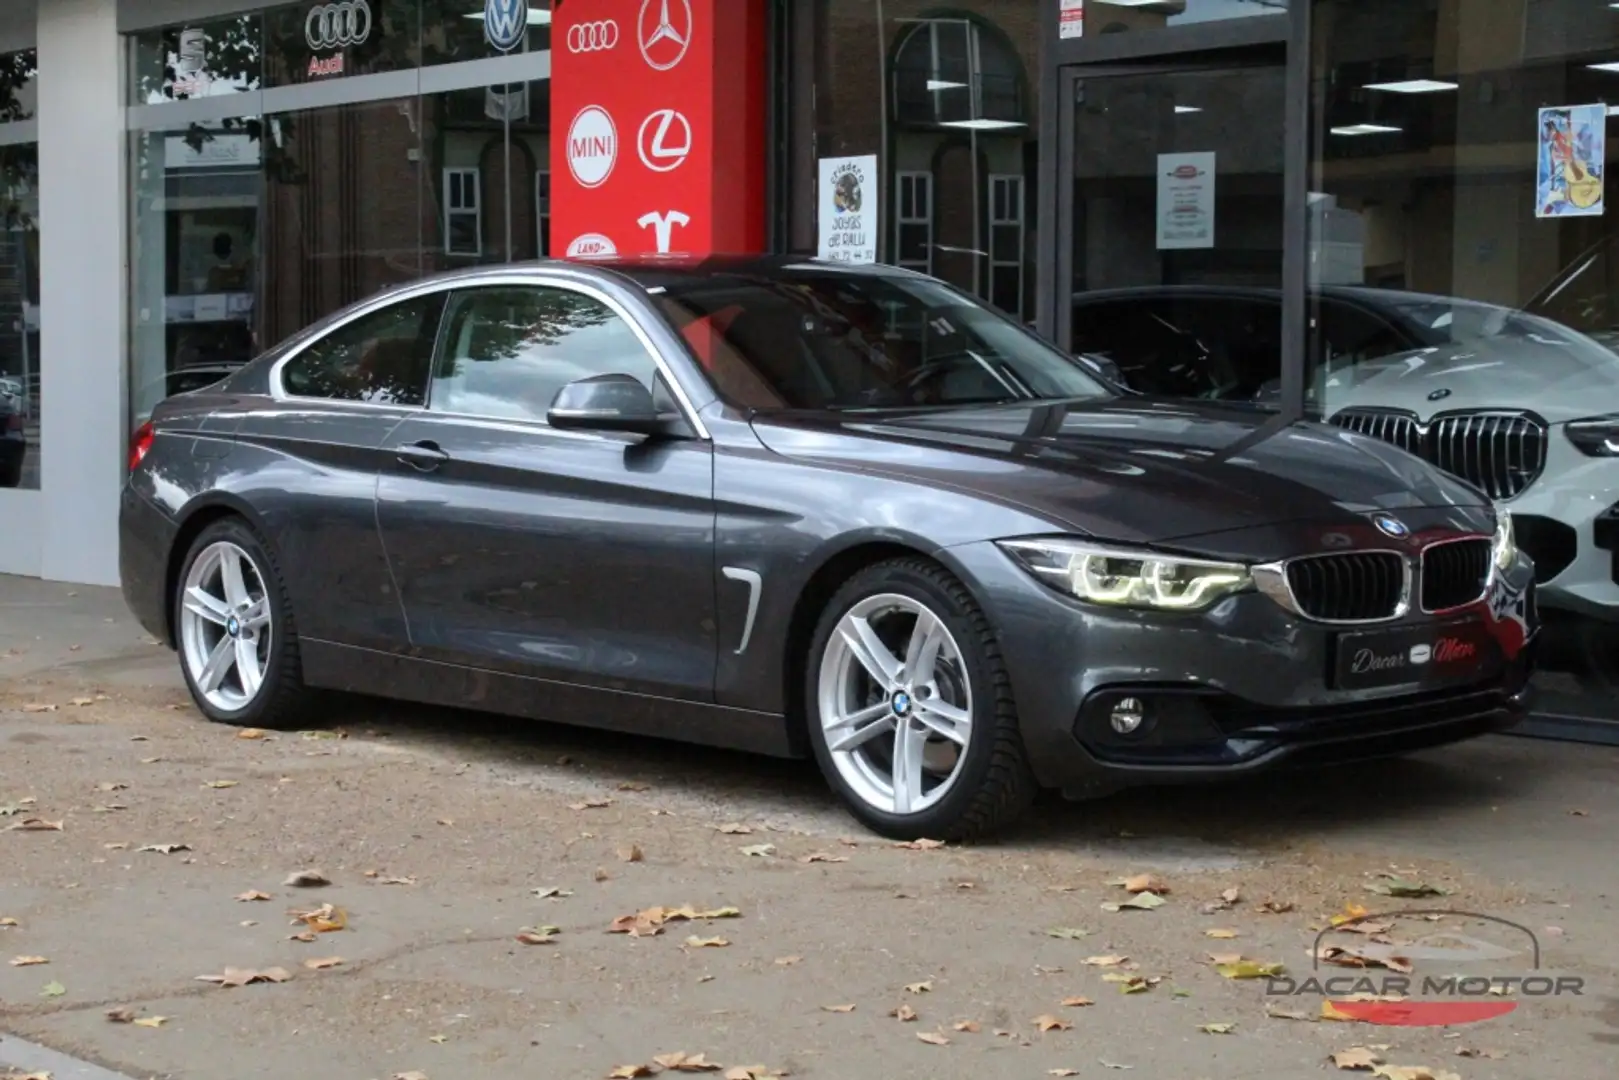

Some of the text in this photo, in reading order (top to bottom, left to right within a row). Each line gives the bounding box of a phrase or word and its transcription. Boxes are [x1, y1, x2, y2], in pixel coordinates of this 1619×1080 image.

[308, 52, 343, 76] Audi
[572, 135, 611, 159] MINI
[1351, 648, 1405, 673] Dacar
